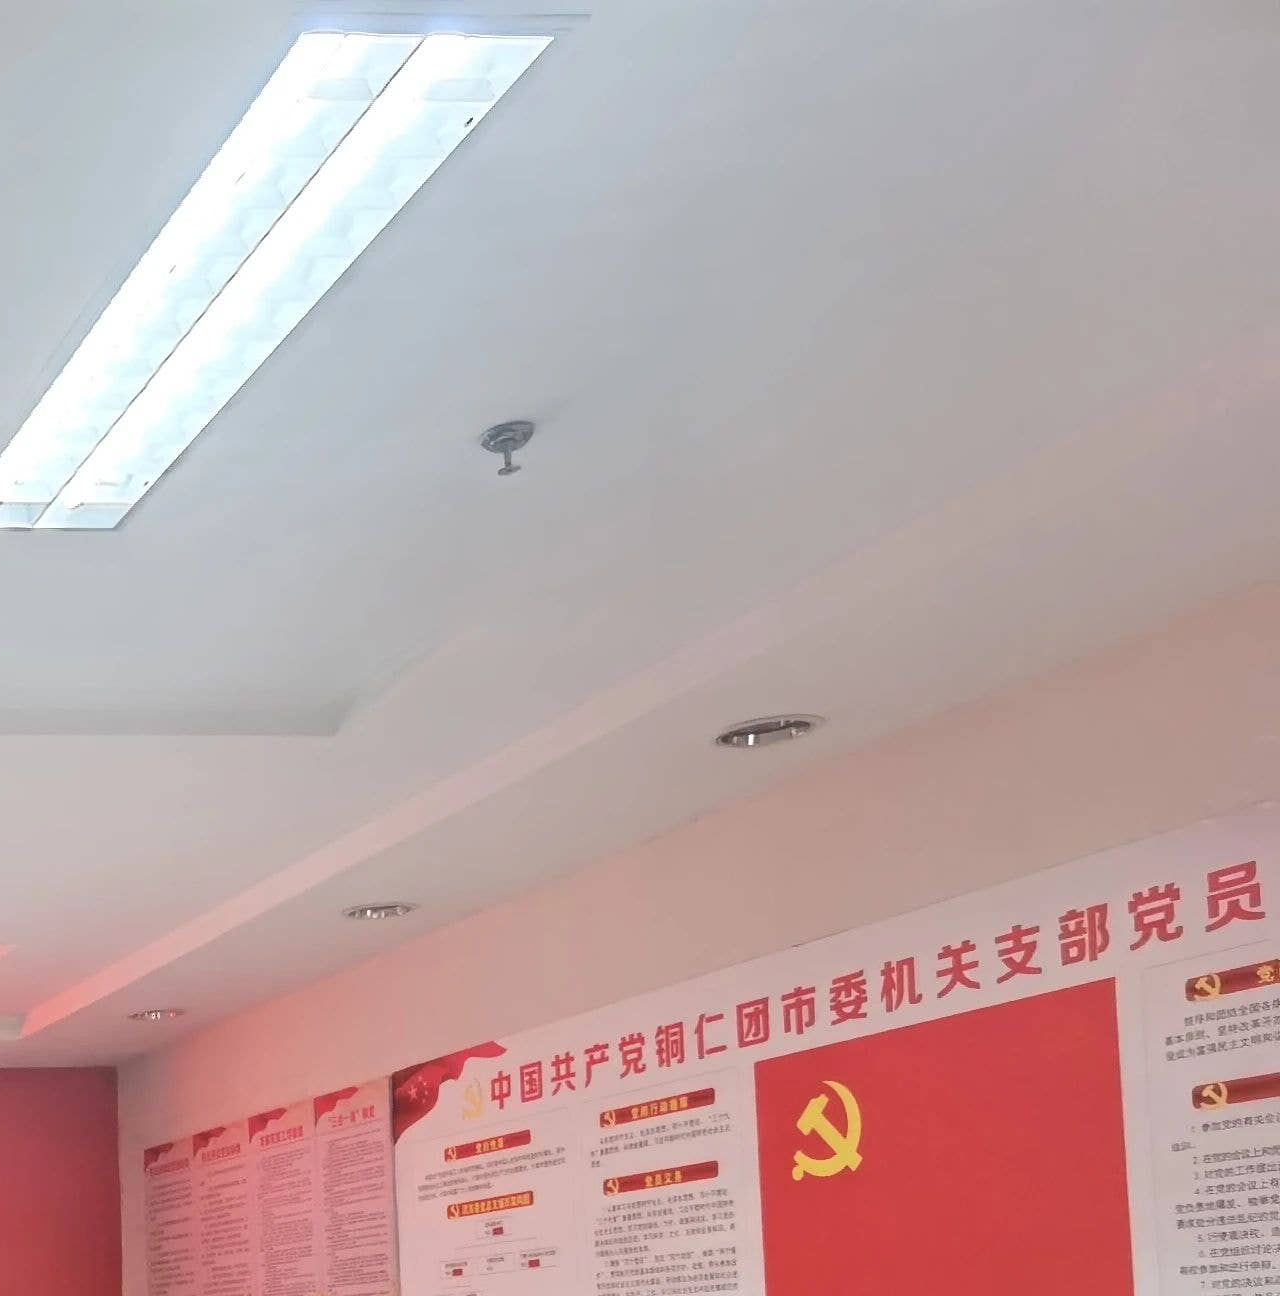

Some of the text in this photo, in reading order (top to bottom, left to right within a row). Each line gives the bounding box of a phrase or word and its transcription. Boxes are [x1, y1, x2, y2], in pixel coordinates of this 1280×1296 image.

[491, 861, 1266, 1109] 中国共产党铜仁团市委机关支部党员
